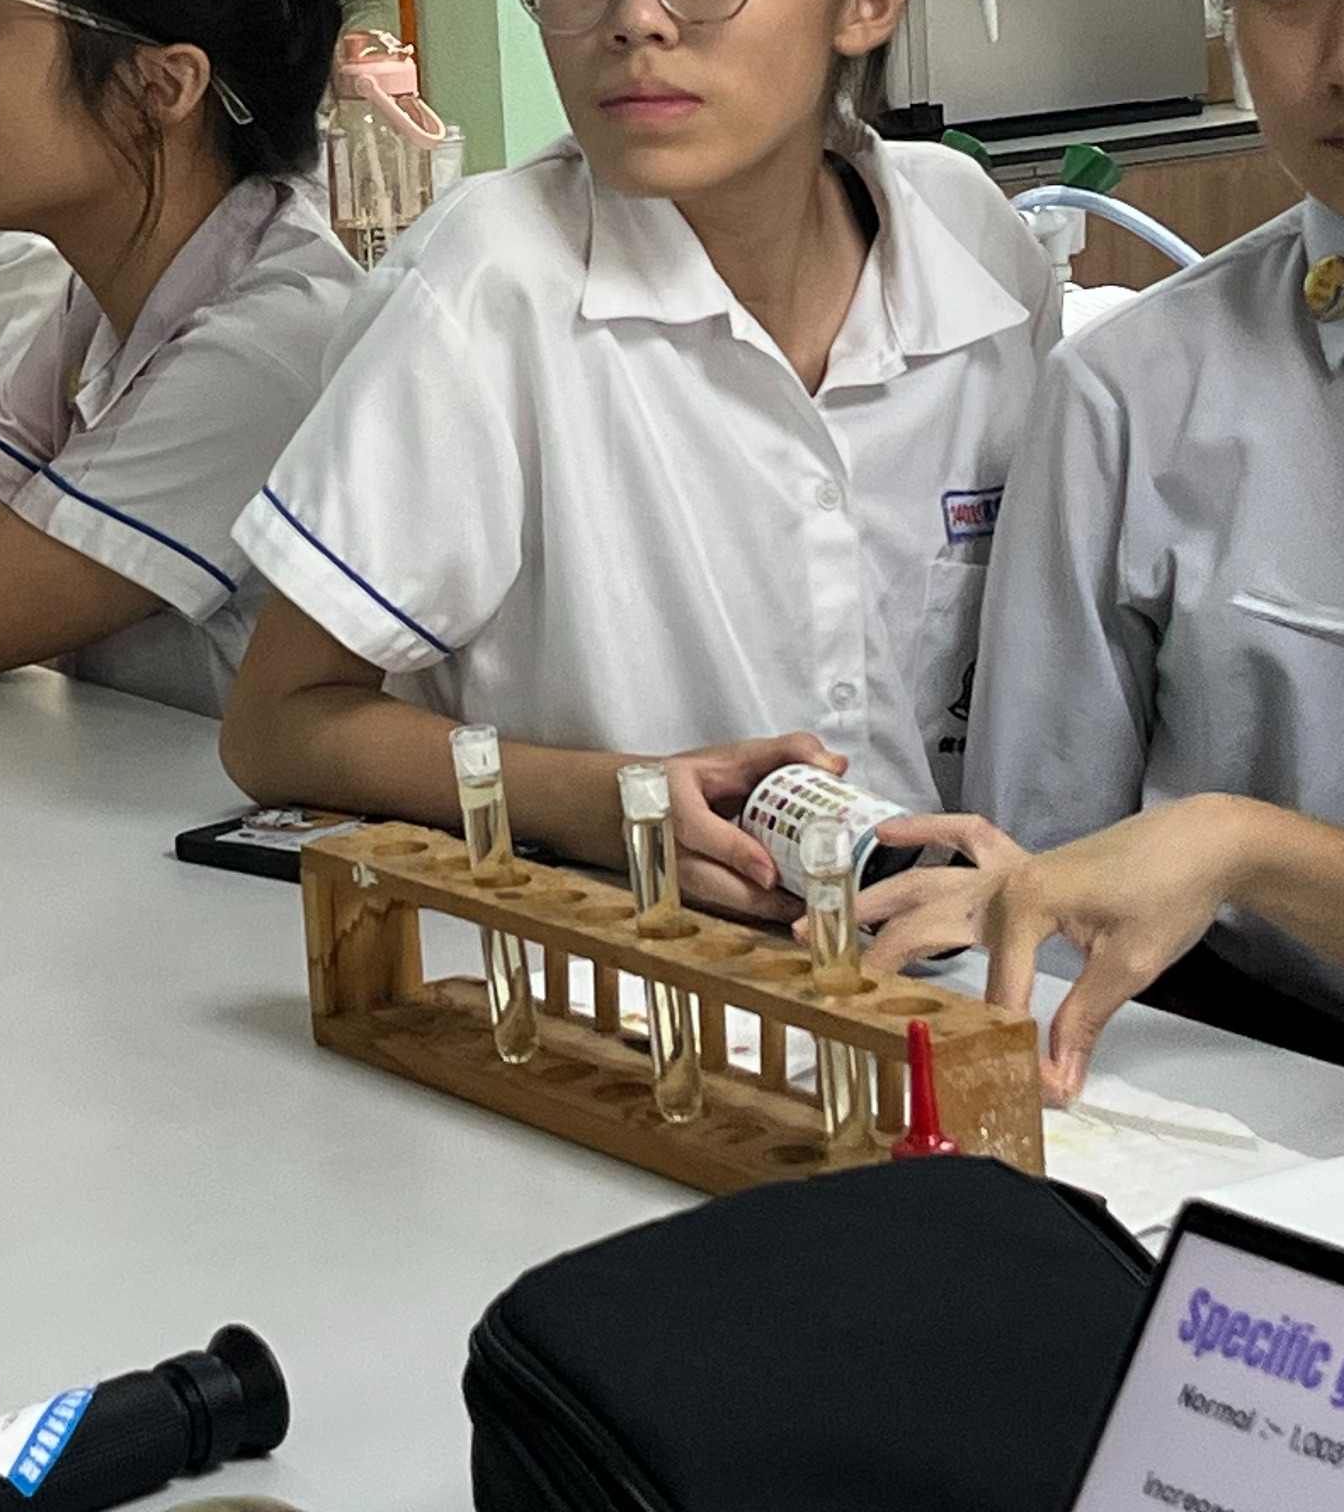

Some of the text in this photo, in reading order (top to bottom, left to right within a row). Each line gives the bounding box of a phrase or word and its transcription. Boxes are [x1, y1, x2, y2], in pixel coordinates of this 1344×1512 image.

[1178, 1288, 1332, 1389] Specific
[1177, 1383, 1257, 1433] Normal
[1143, 1470, 1235, 1512] Increa
